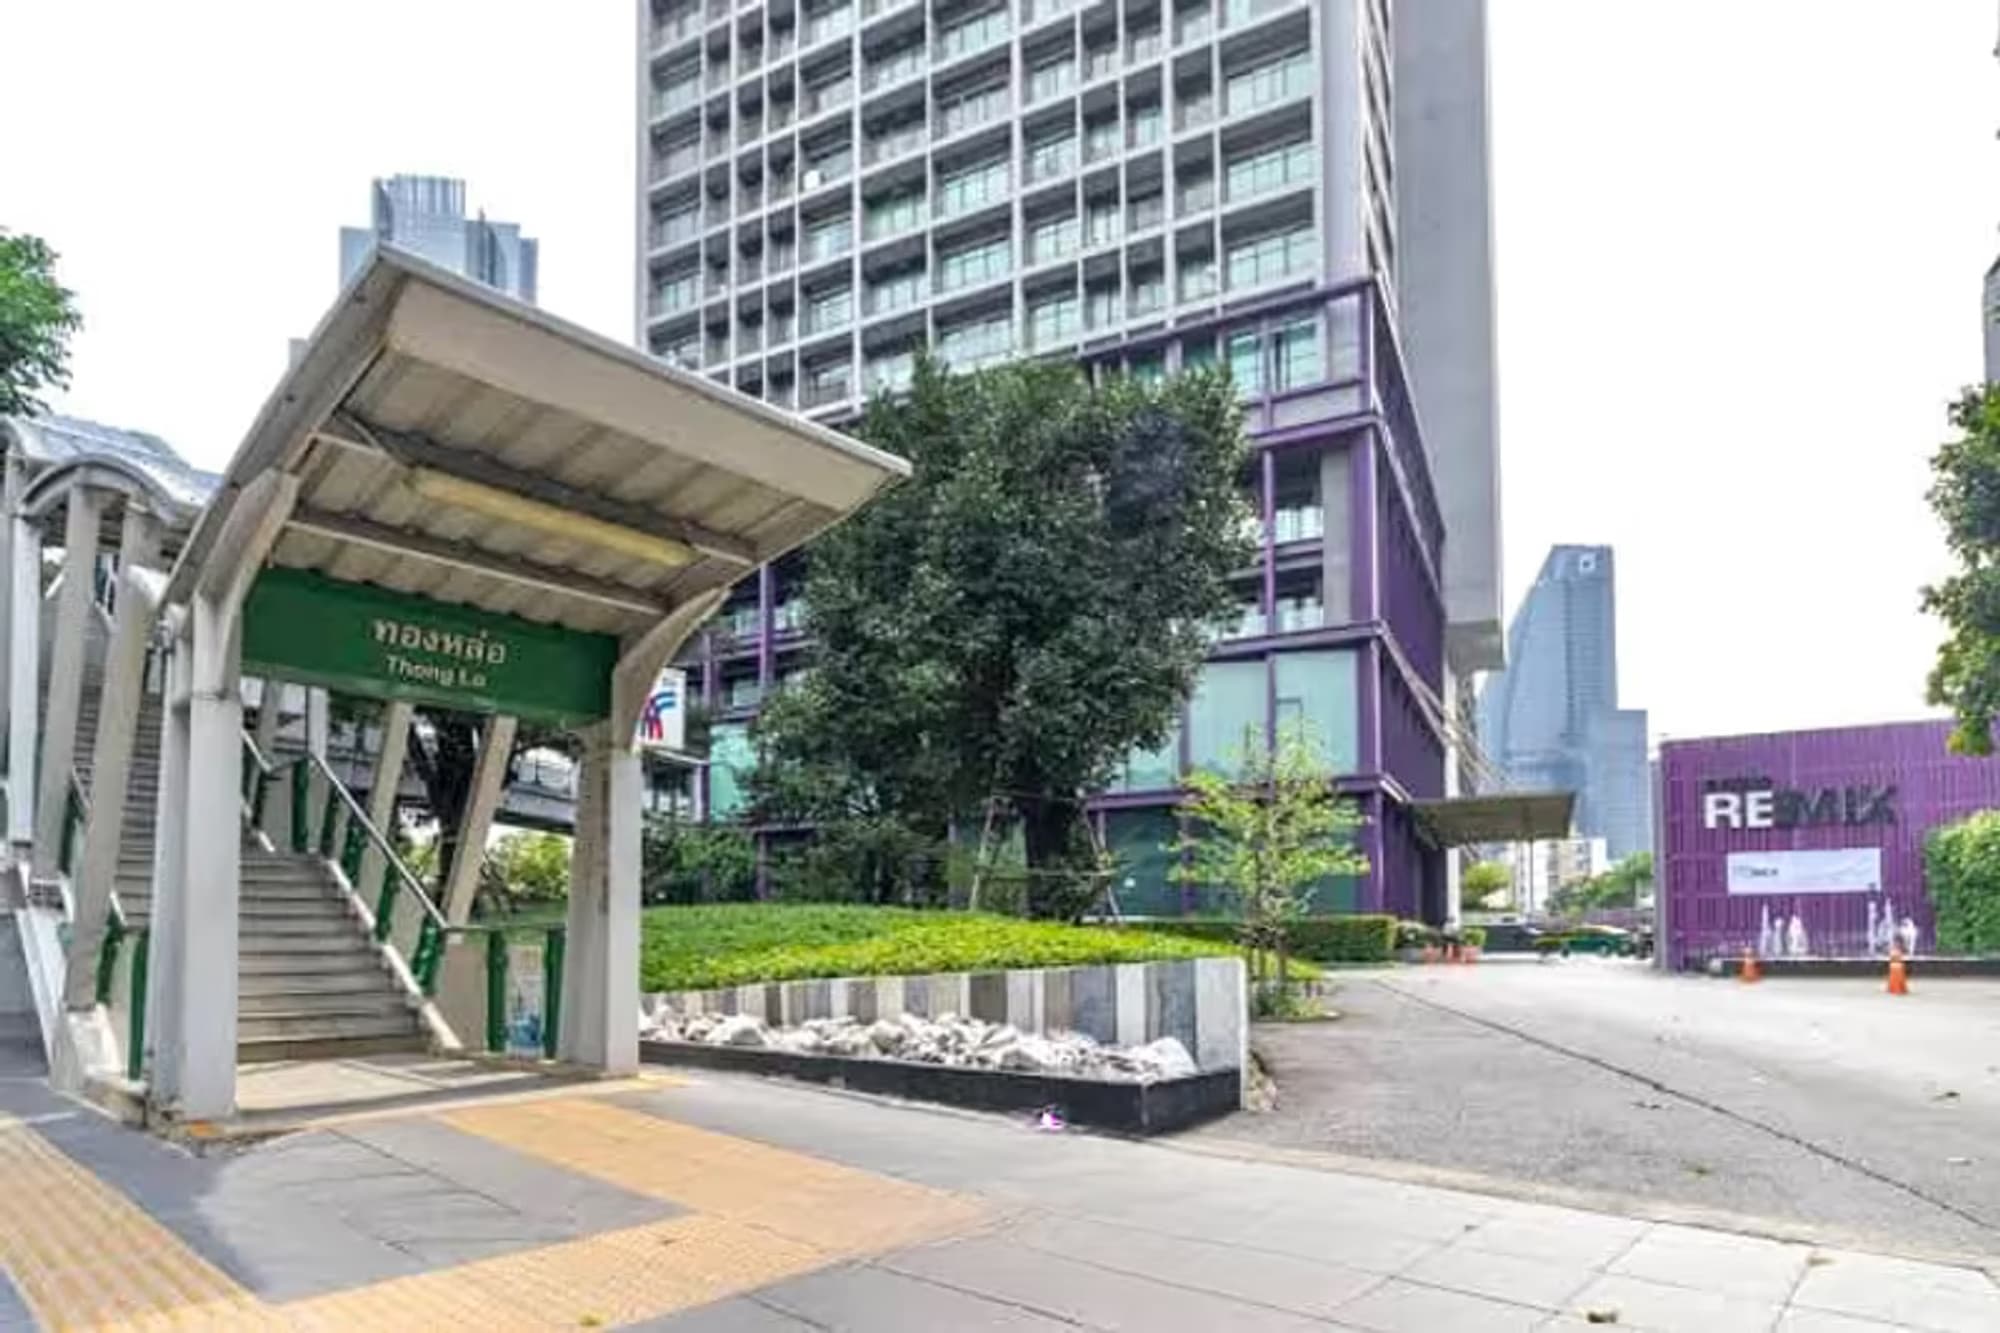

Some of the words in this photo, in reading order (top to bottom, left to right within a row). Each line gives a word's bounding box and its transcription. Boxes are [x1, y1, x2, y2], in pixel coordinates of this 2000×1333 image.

[372, 619, 506, 664] ทองหล่อ
[386, 654, 454, 687] Thong
[459, 669, 487, 687] Lo
